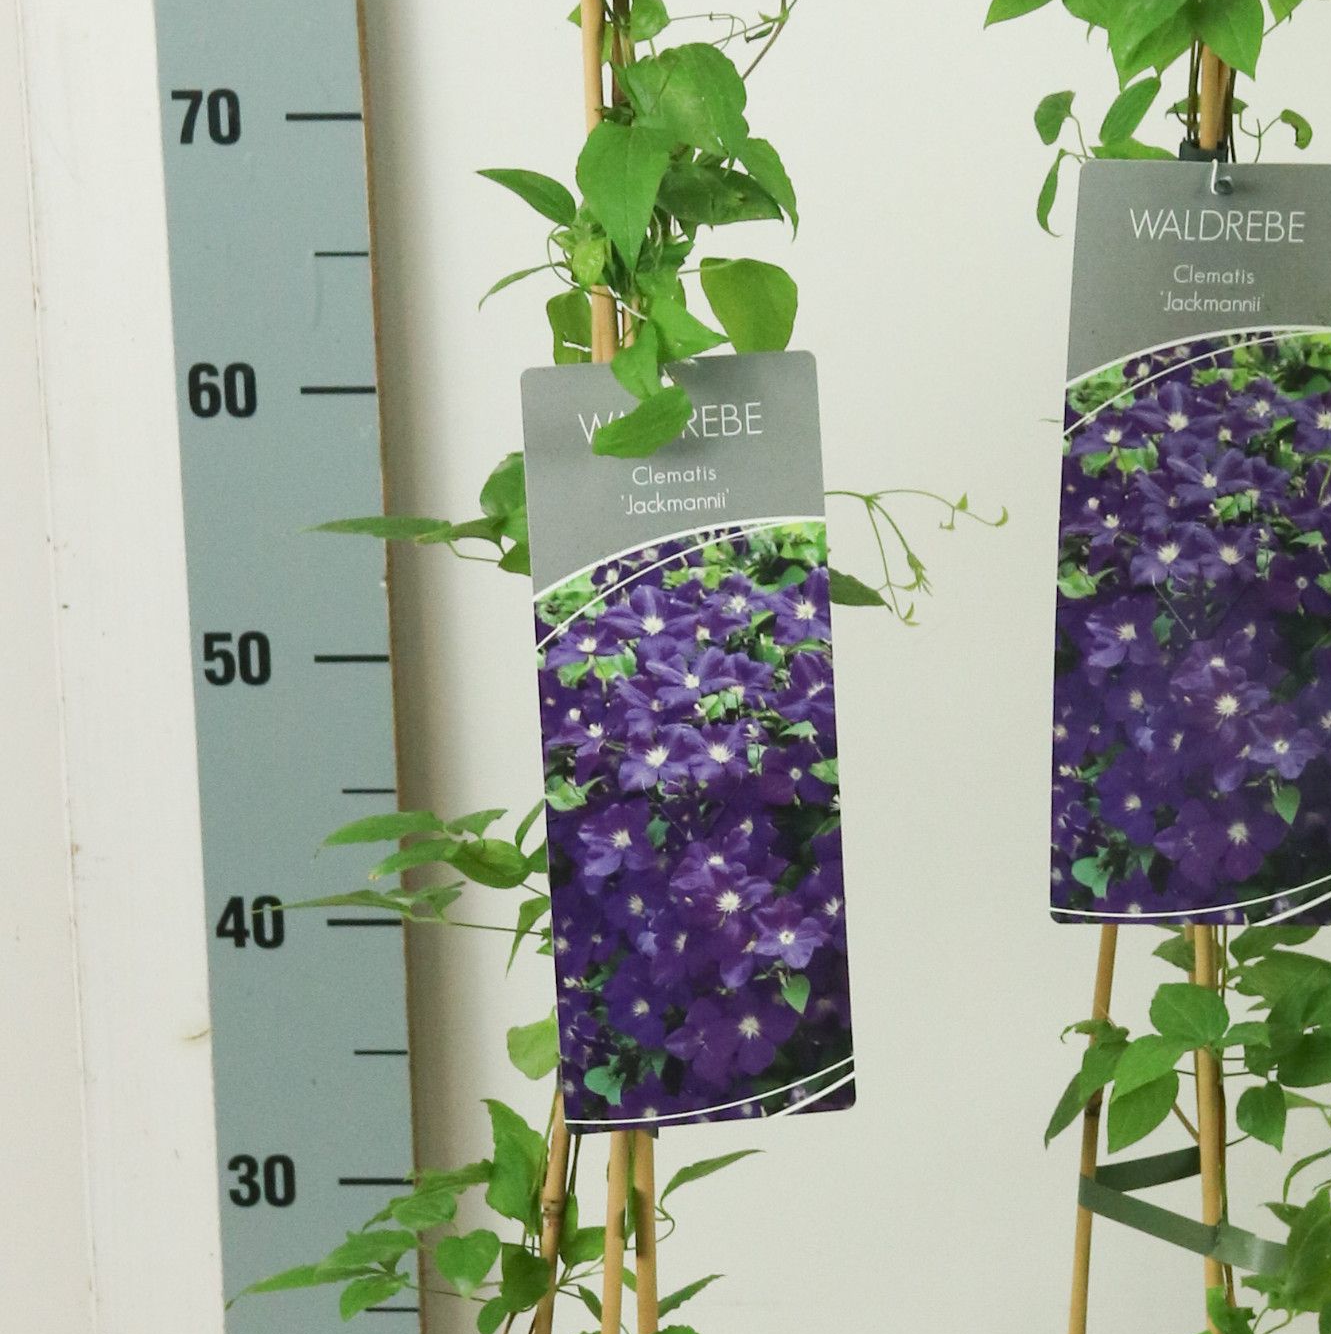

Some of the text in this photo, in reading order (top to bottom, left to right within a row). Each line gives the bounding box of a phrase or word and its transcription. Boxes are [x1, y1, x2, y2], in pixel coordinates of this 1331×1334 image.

[171, 88, 241, 146] 70
[1130, 208, 1305, 243] WALDREBE
[1174, 264, 1254, 284] Clematis
[188, 362, 257, 419] 60
[578, 402, 763, 444] WREBE
[632, 465, 716, 486] Clematis
[203, 631, 271, 686] 50
[216, 895, 285, 950] 40
[227, 1154, 296, 1208] 30
